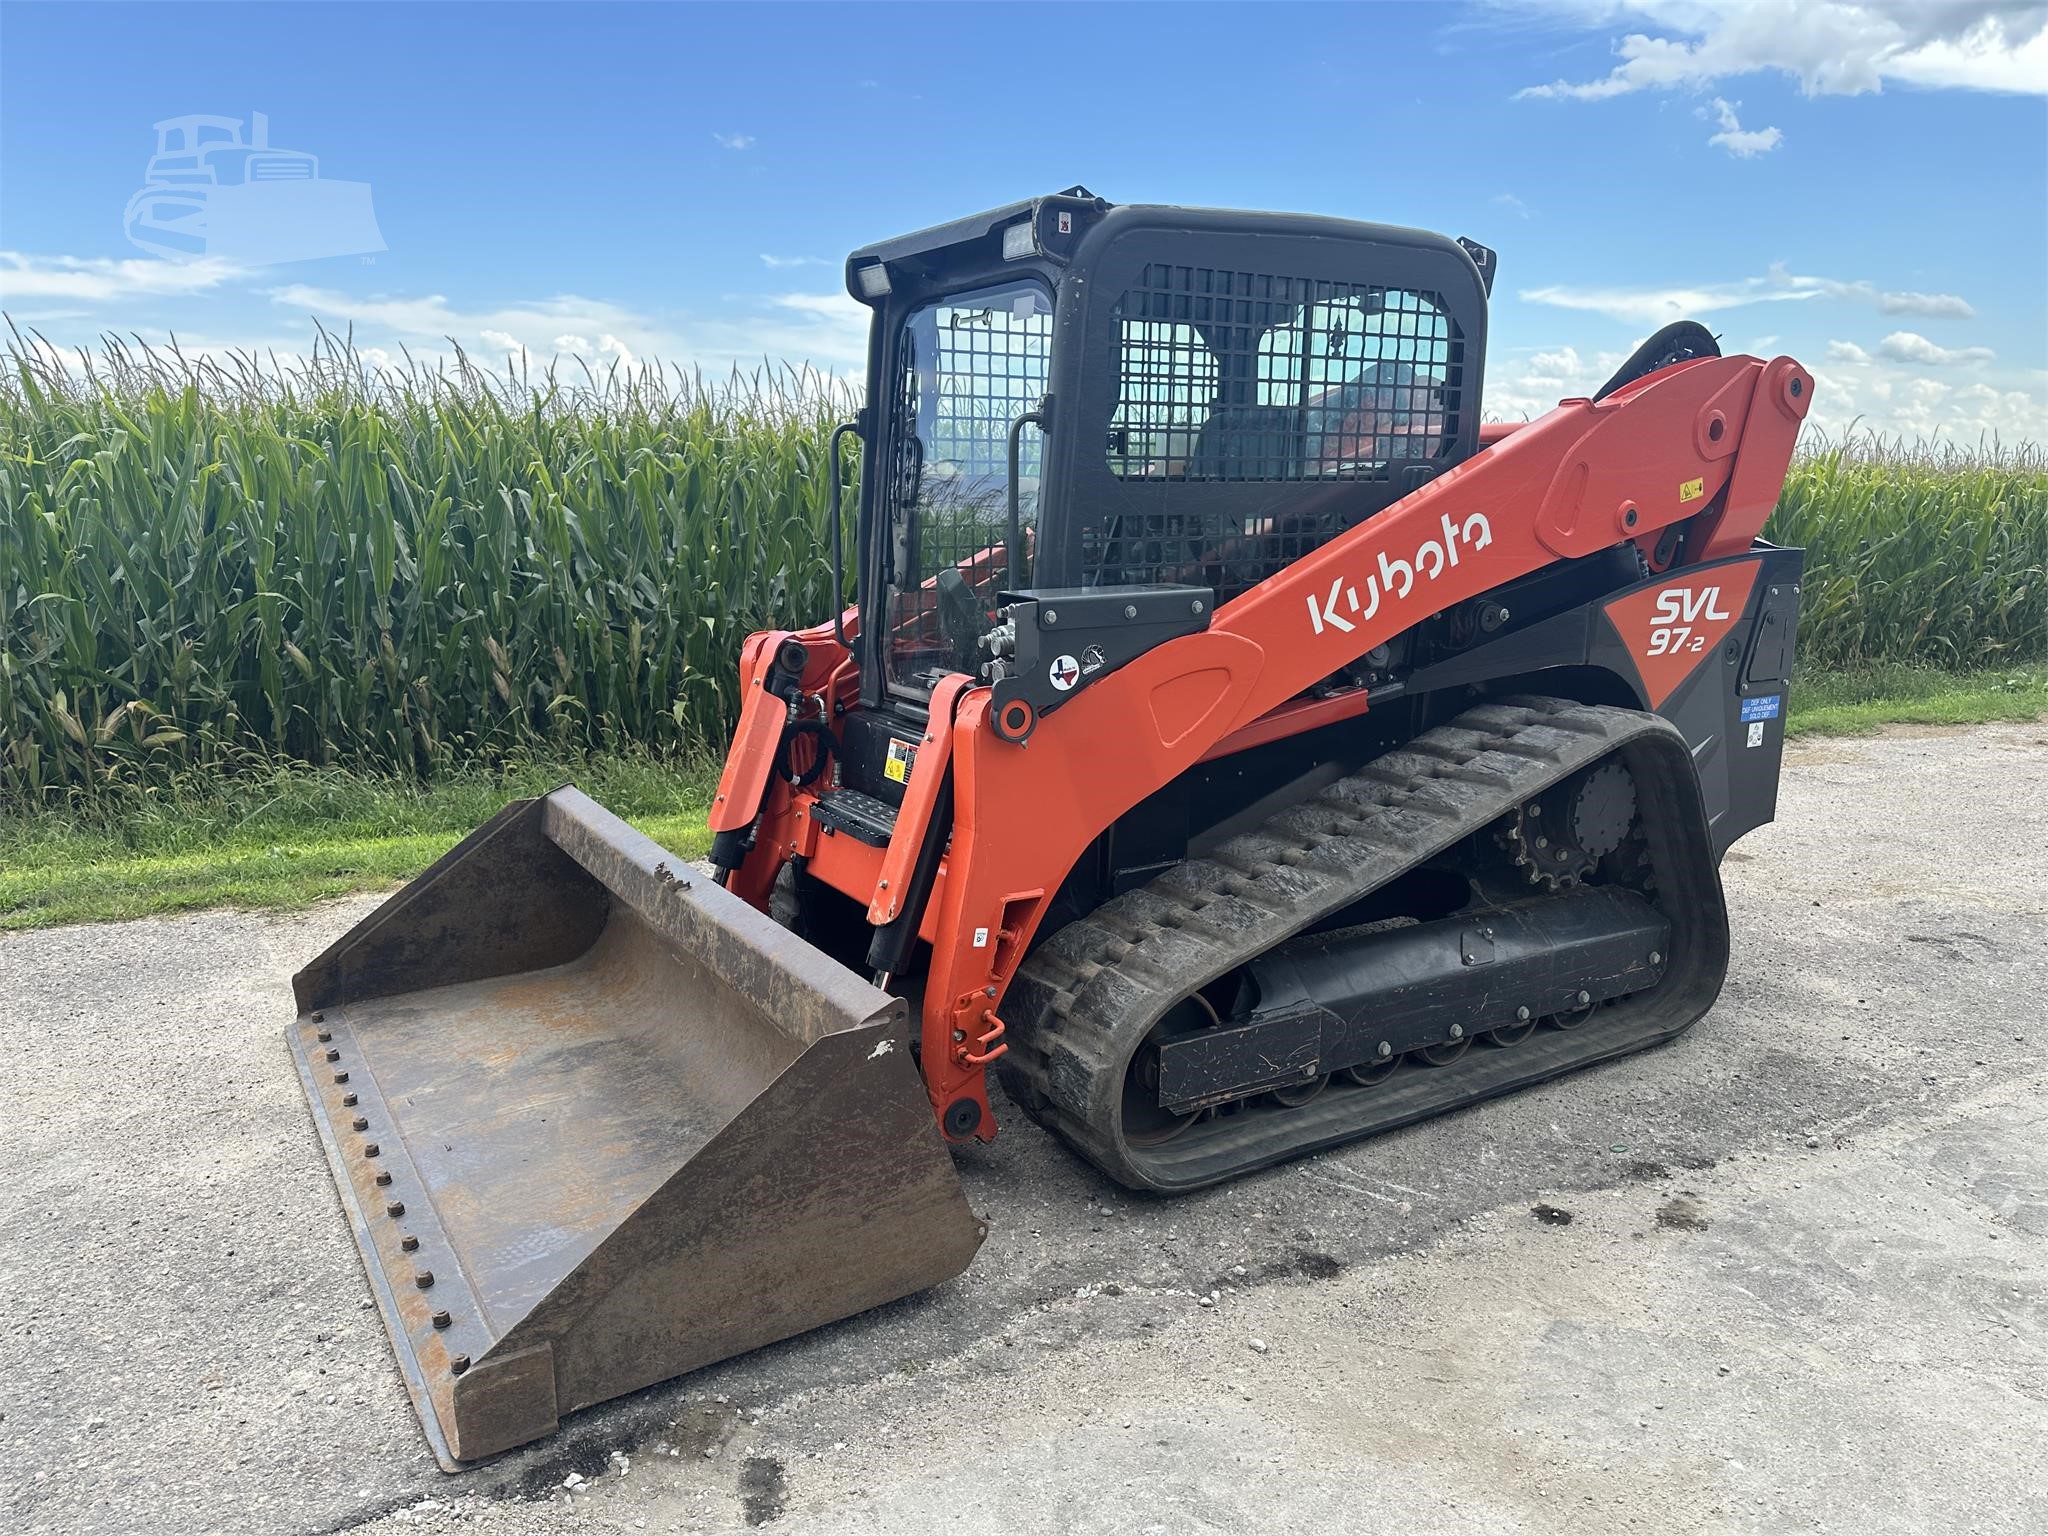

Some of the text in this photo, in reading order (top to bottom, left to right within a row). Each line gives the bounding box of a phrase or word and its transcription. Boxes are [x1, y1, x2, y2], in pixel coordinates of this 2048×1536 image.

[1306, 512, 1493, 635] Kubota
[1649, 586, 1730, 625] SVL
[1646, 626, 1705, 656] 97-2
[1742, 706, 1751, 714] DEF
